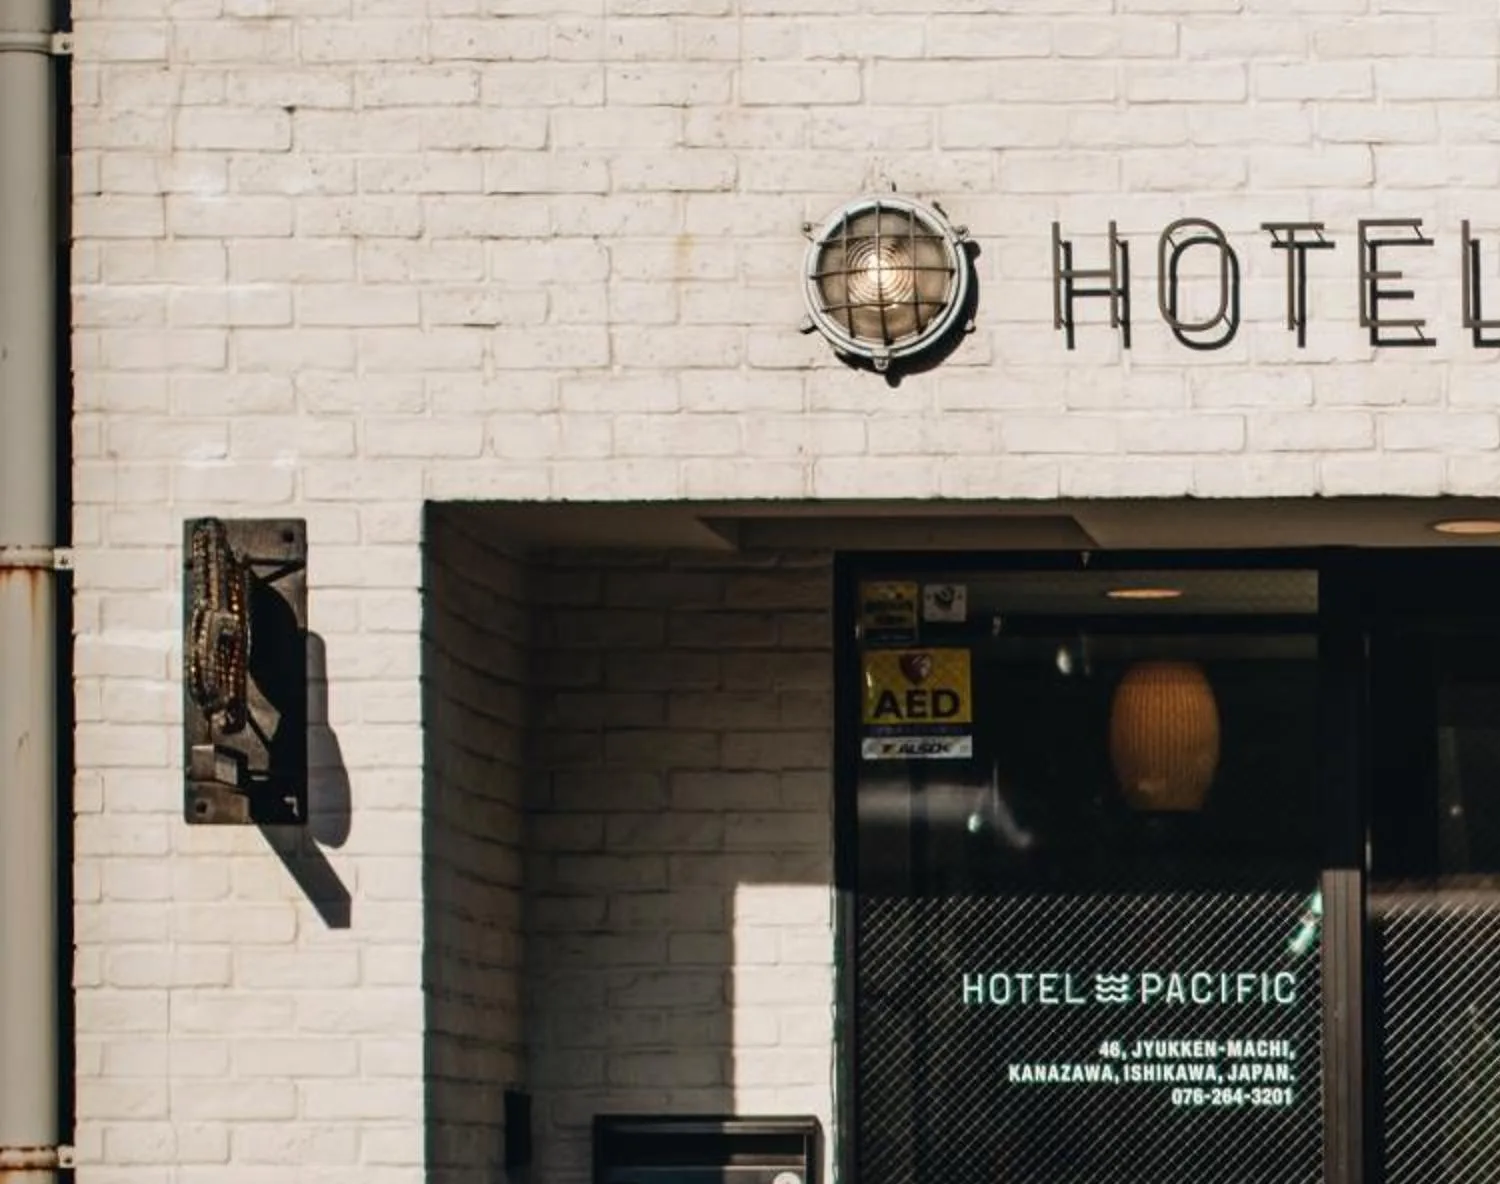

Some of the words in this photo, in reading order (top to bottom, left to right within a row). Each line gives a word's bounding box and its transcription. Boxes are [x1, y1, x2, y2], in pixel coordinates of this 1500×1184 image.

[873, 689, 961, 720] AED
[963, 973, 1086, 1004] HOTEL
[1141, 972, 1297, 1004] PACIFIC
[1131, 1040, 1297, 1061] JYUKKEN-MACHI,
[1008, 1064, 1120, 1085] KANAZAWA,
[1124, 1064, 1224, 1085] ISHIKAWA,
[1228, 1064, 1296, 1083] JAPAN.
[1171, 1087, 1294, 1106] 076-264-3201
